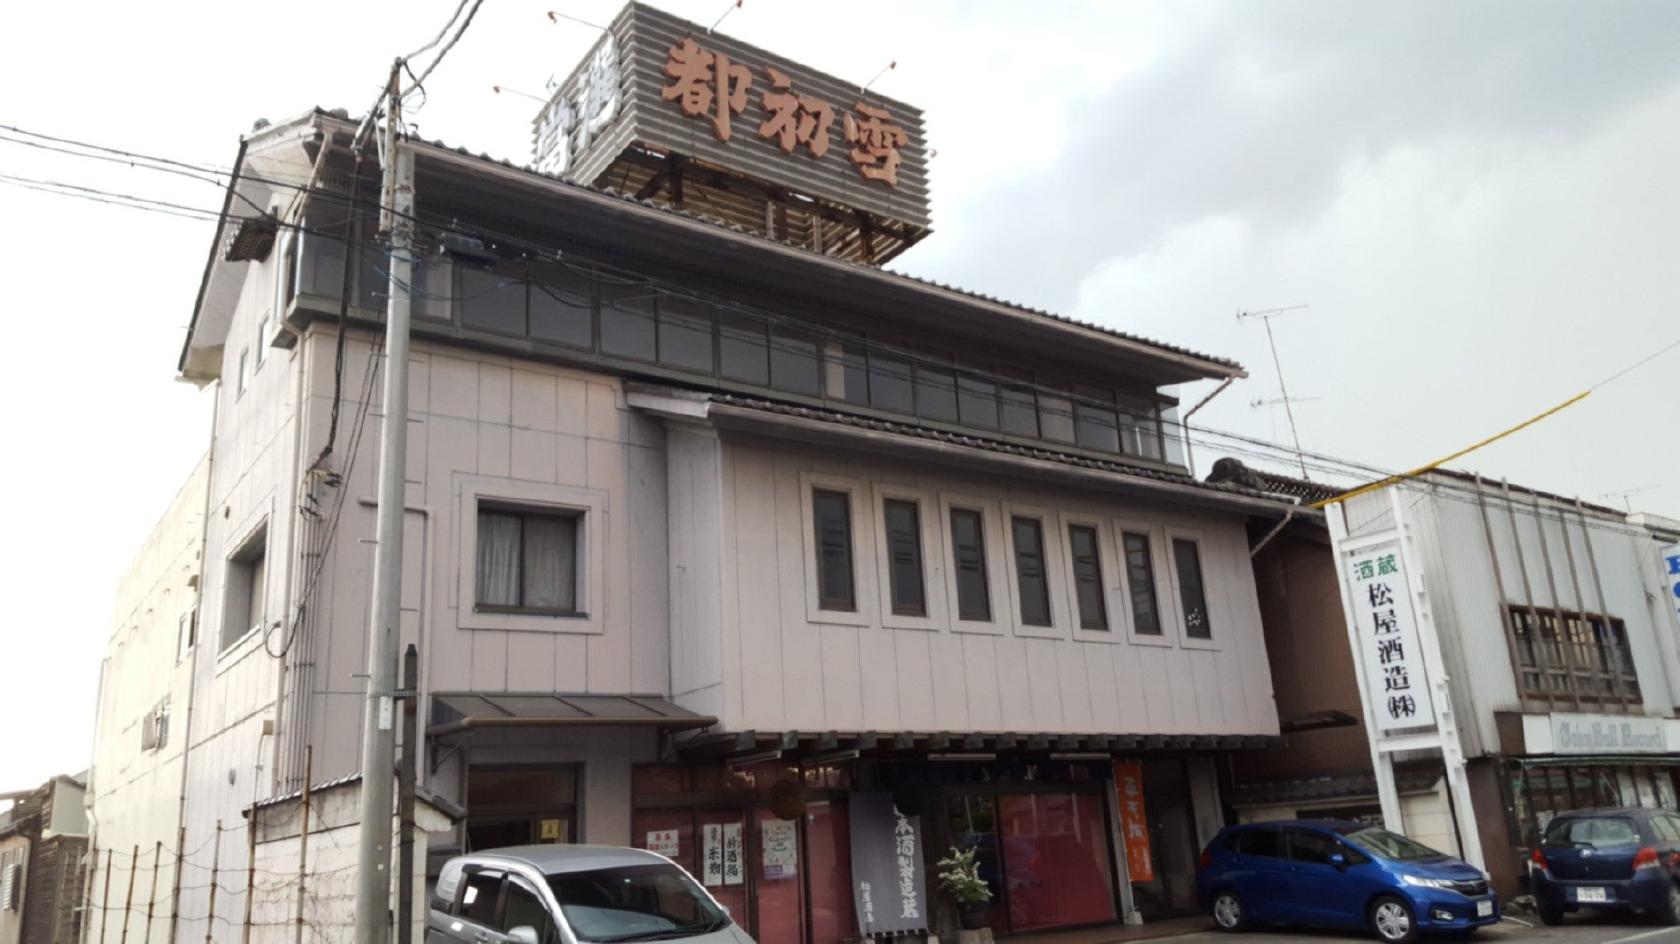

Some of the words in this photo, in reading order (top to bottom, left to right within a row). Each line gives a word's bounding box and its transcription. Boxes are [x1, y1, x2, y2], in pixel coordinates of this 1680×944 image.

[661, 37, 909, 187] 都初雪
[1353, 553, 1398, 581] 酒蔵
